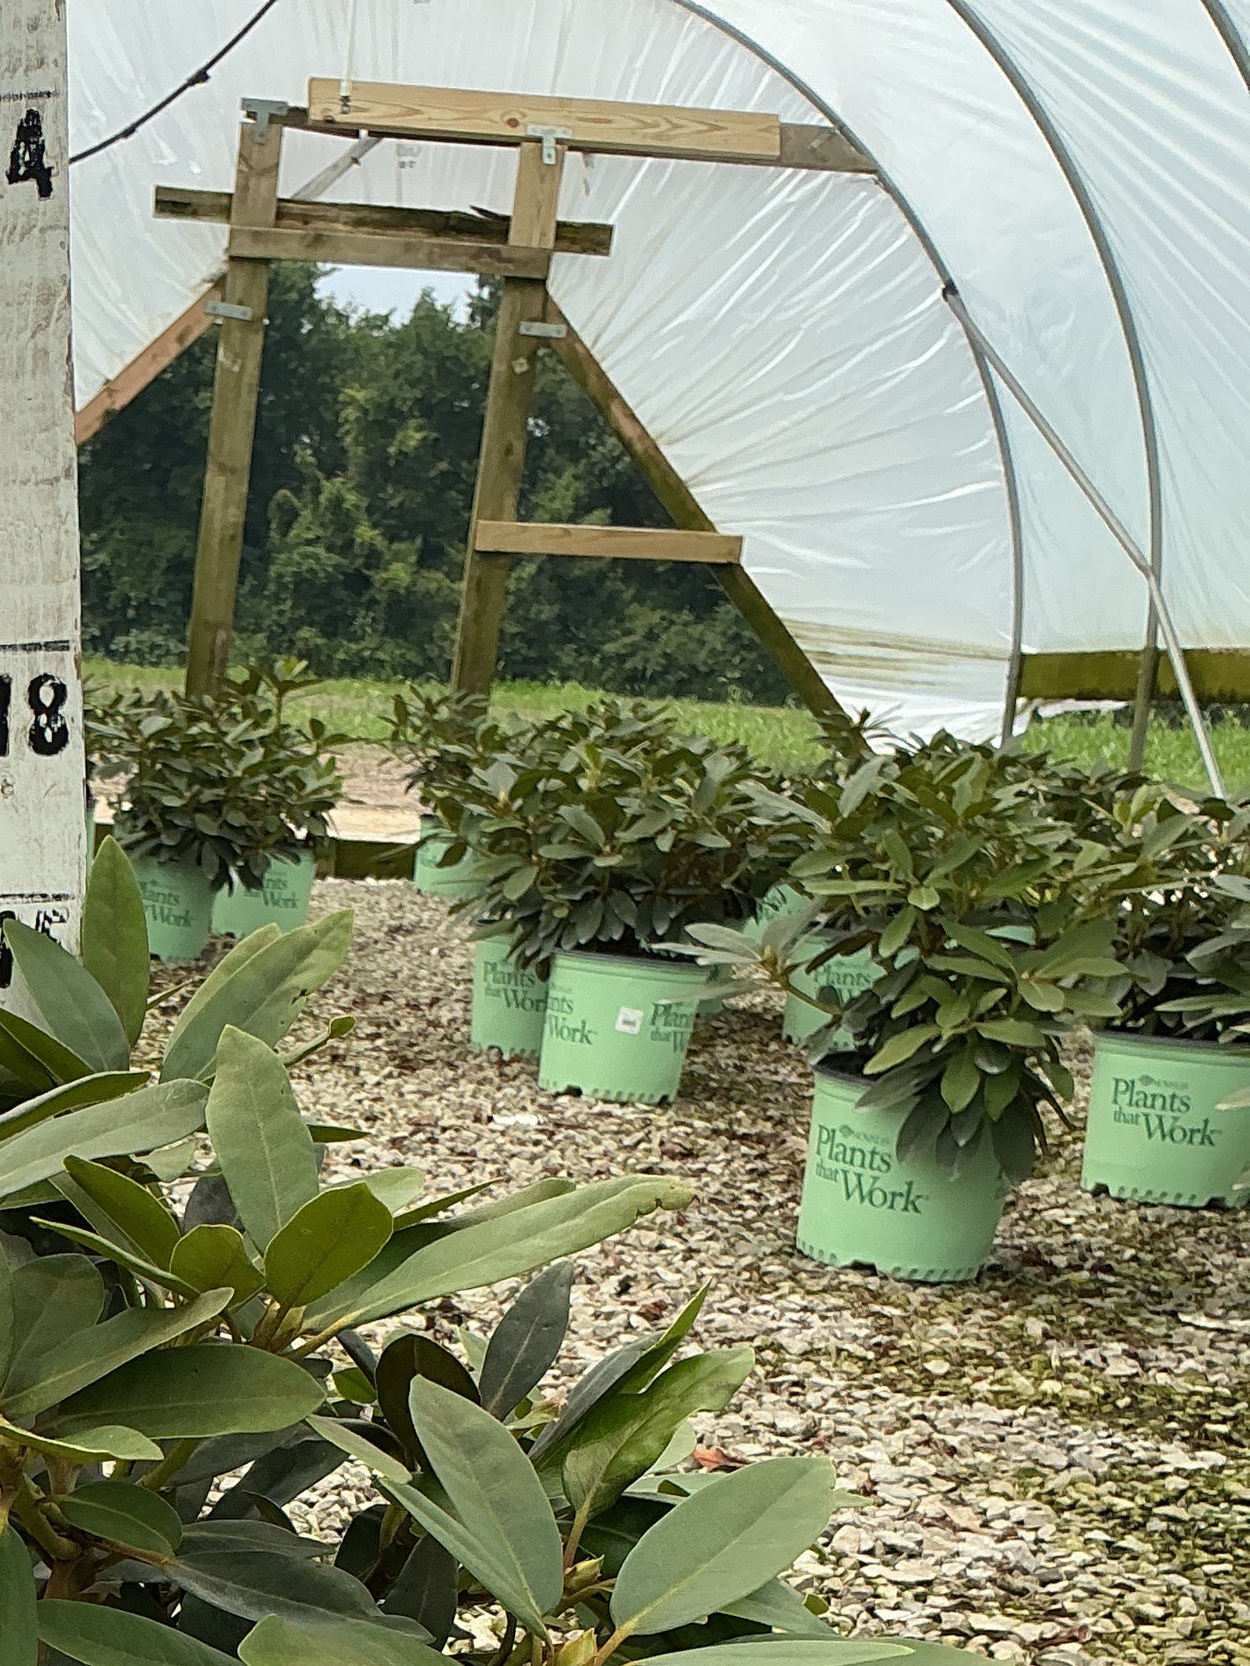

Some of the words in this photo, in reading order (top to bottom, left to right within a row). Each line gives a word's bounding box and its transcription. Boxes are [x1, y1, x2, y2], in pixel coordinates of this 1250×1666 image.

[1111, 1076, 1192, 1114] Plants
[815, 1124, 893, 1174] Plants
[1113, 1106, 1142, 1127] that
[1141, 1111, 1216, 1148] Work
[814, 1158, 840, 1184] that
[840, 1167, 923, 1215] Work
